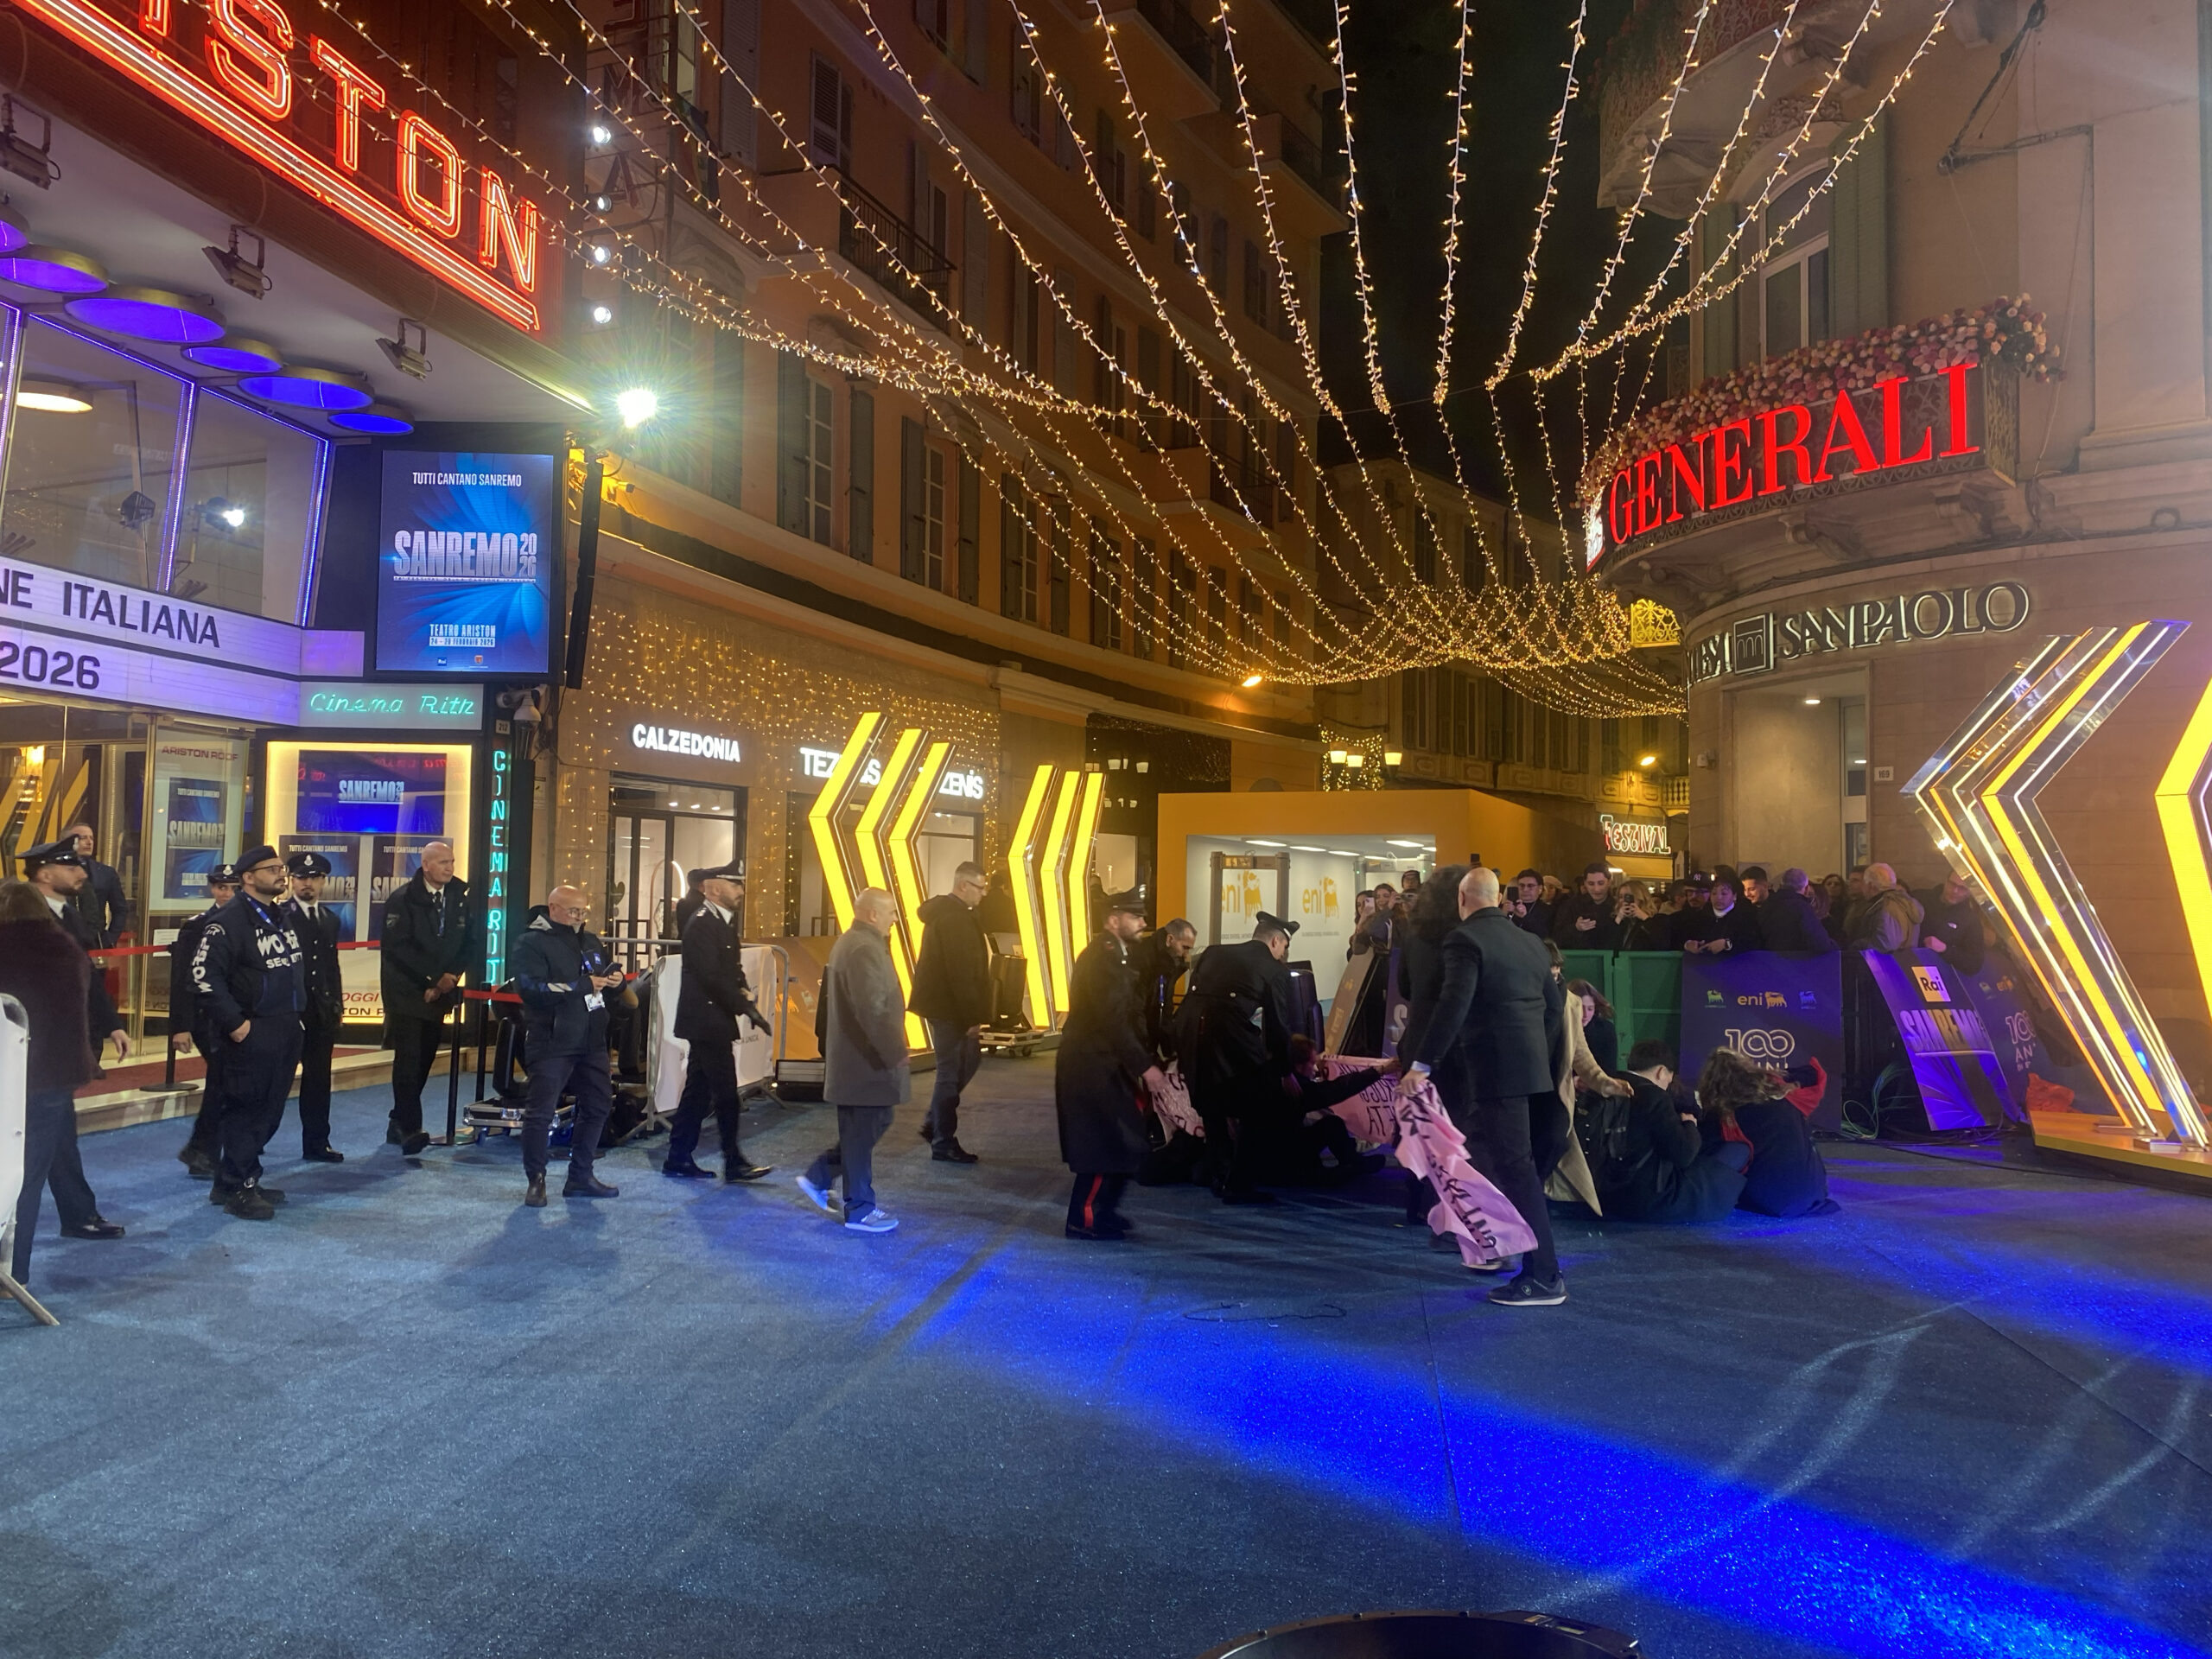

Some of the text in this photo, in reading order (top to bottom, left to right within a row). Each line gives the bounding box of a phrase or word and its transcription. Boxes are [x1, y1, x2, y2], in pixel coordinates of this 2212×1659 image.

[1609, 363, 1980, 544] GENERALI
[412, 472, 522, 487] TUTTI CANTANO SANREMO
[394, 530, 537, 577] SANREMO 20
[518, 556, 537, 578] 26
[62, 581, 219, 648] ITALIANA
[1779, 582, 2030, 660] SANPAOLO
[429, 624, 496, 638] TEATRO ARISTON
[0, 641, 100, 690] 2026
[310, 692, 404, 713] Cinema
[162, 746, 238, 761] ARISTON ROOF
[632, 723, 741, 762] CALZEDONIA
[339, 779, 396, 802] SANREMO
[488, 749, 505, 898] CINEMA
[1302, 880, 1322, 914] eni
[1737, 993, 1764, 1006] eni
[1920, 976, 1944, 992] Rai
[1725, 1028, 1796, 1059] 100
[1899, 1008, 1986, 1052] SANREMO
